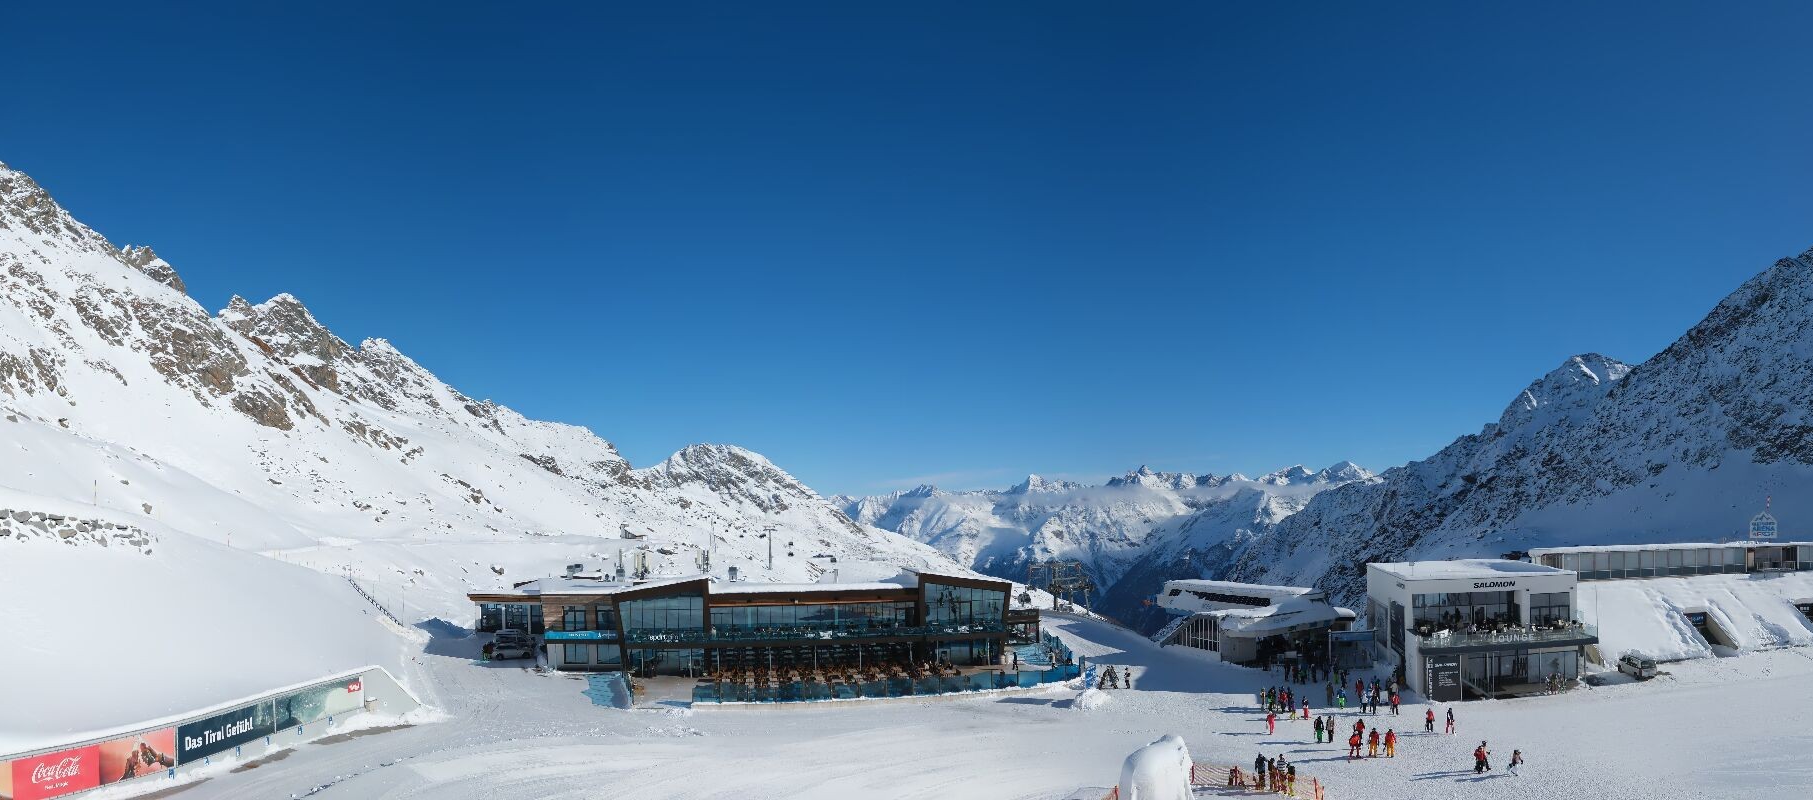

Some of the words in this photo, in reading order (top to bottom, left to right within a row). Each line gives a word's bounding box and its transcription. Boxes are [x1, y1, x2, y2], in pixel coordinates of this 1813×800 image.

[1473, 580, 1516, 589] SALOMON
[1491, 633, 1535, 643] LOUNGE
[184, 736, 203, 751] Das
[203, 725, 225, 745] Tirol
[226, 716, 254, 738] Gefühl
